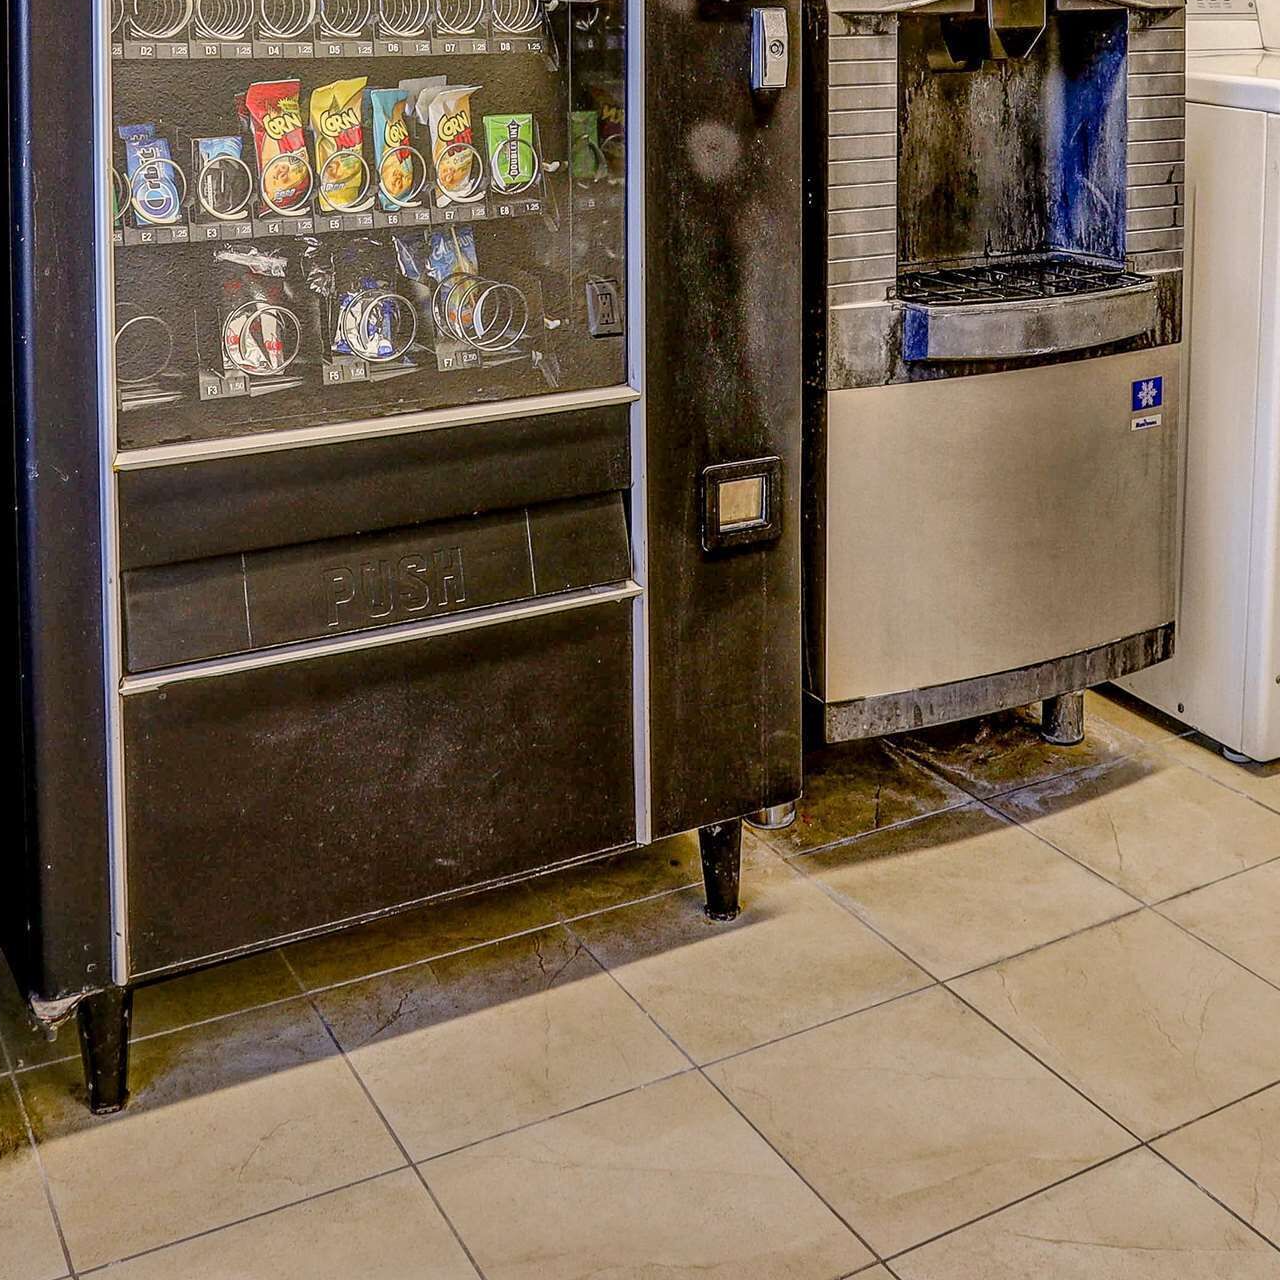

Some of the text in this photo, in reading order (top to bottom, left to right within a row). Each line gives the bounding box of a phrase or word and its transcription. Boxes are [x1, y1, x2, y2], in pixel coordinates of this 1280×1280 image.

[140, 44, 188, 56] D2 1.25
[205, 45, 252, 56] D3 1.25
[268, 45, 313, 56] D4 1.25
[329, 45, 372, 56] D5 1.25
[387, 43, 430, 53] D6 1.25
[445, 42, 487, 52] D7 1.25
[527, 42, 541, 51] 1.25
[262, 112, 303, 140] CORN
[319, 108, 361, 137] CORN
[437, 110, 471, 142] CORN
[384, 117, 409, 148] CORN
[445, 208, 486, 221] E7 1.25
[499, 203, 540, 216] E8 1.25
[329, 216, 373, 229] E5 1.25
[388, 212, 430, 225] E6 1.25
[206, 226, 252, 238] E3 1.25
[268, 221, 313, 233] E4 1.25
[141, 229, 188, 242] E2 1.25
[443, 358, 453, 368] F7
[350, 368, 365, 377] 1.50
[207, 382, 245, 395] F3 1.50
[322, 545, 467, 627] PUSH
